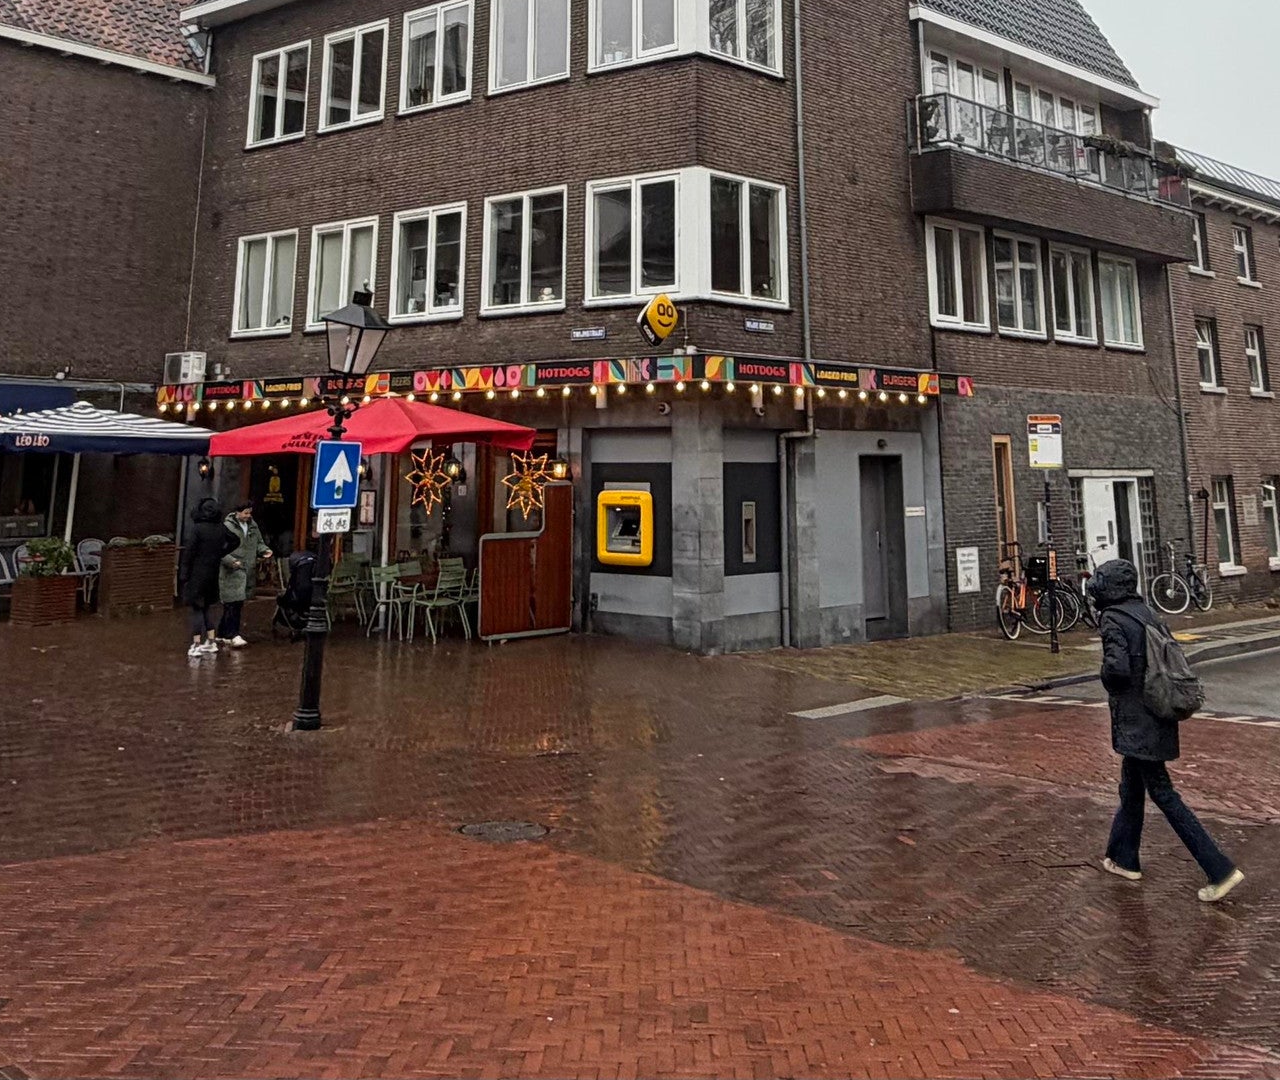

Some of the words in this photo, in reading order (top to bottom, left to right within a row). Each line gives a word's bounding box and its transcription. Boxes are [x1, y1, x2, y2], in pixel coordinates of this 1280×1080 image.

[538, 366, 590, 379] HOTDOGS
[739, 363, 786, 377] HOTDOGS
[816, 370, 840, 380] LOADED
[840, 372, 857, 381] FRIES
[883, 374, 917, 387] BURGERS
